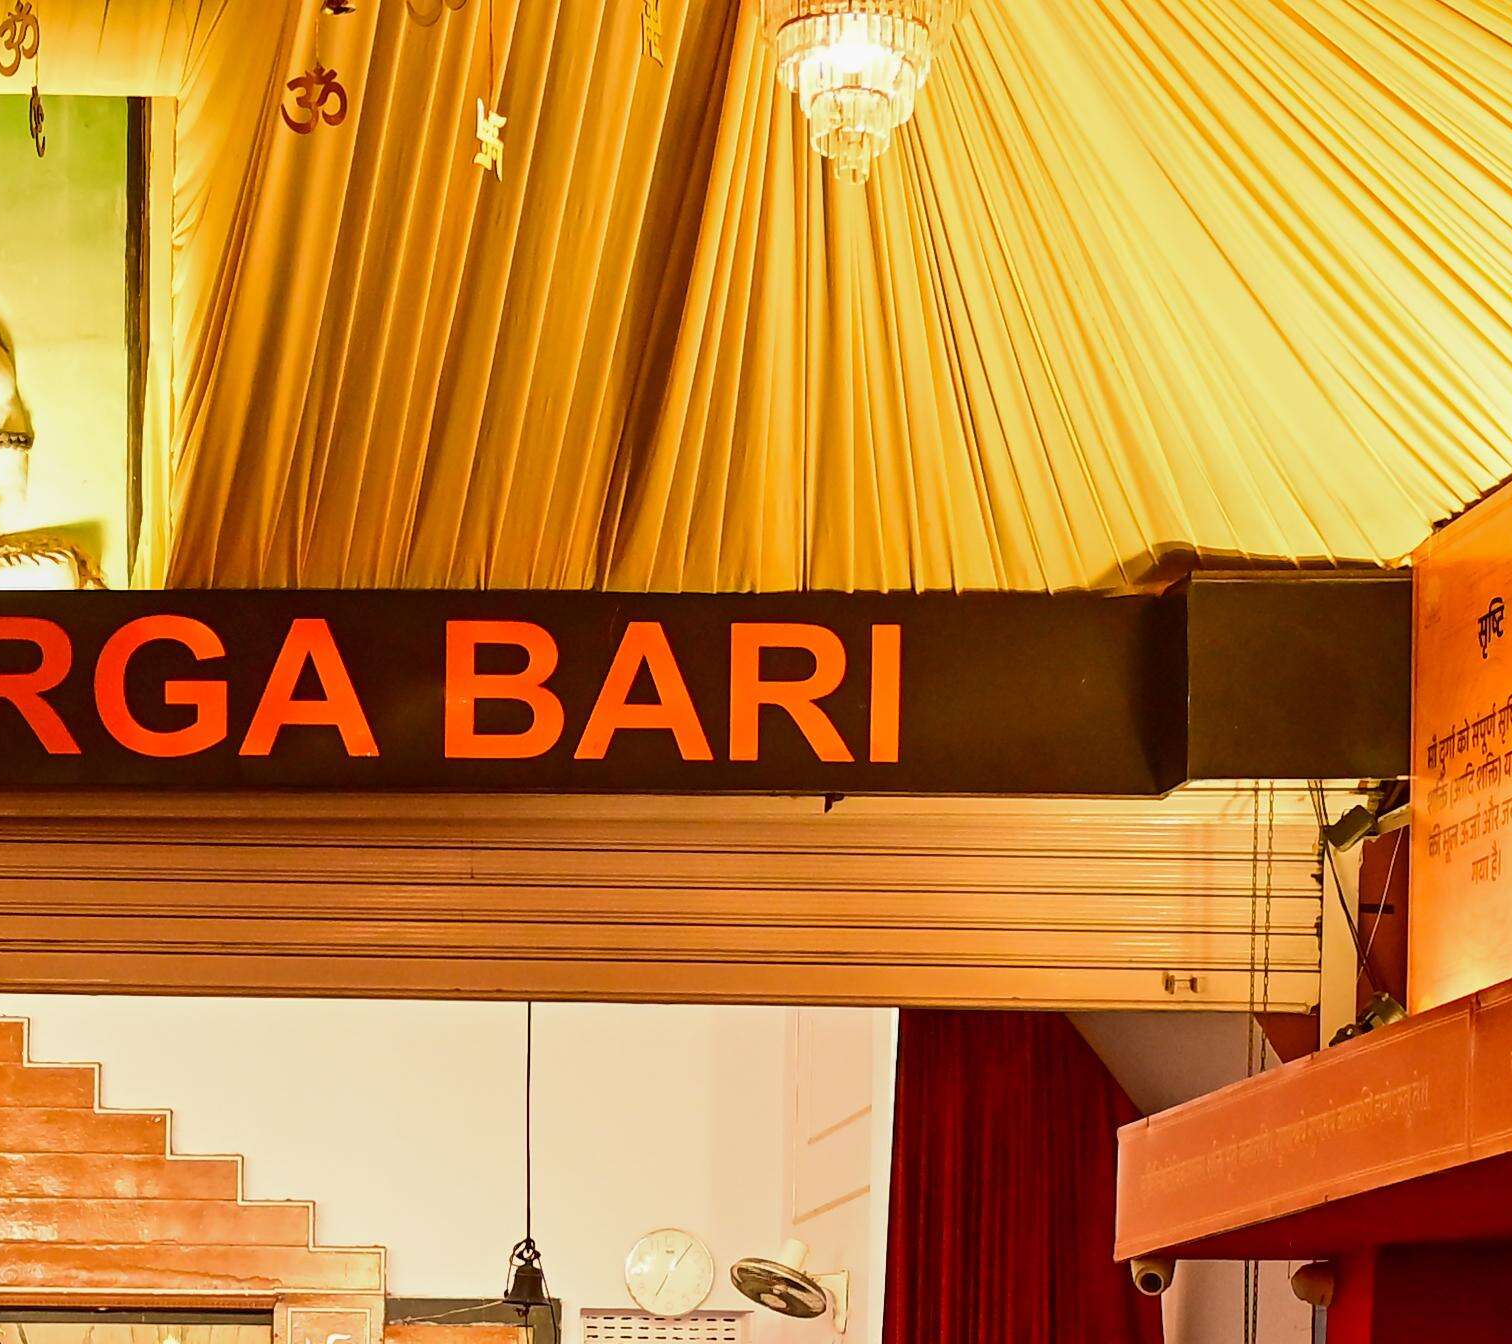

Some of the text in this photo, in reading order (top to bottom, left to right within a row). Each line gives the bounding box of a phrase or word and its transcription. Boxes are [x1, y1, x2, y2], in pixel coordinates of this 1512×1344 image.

[1478, 597, 1505, 659] सृष्टि
[443, 620, 902, 763] BARI
[1439, 724, 1455, 779] दुर्गा
[1457, 718, 1470, 754] को
[1471, 702, 1496, 755] संपूर्ण
[1428, 823, 1441, 857] की
[1460, 803, 1481, 846] ऊर्जा
[1482, 795, 1499, 835] और
[1471, 855, 1489, 884] गया
